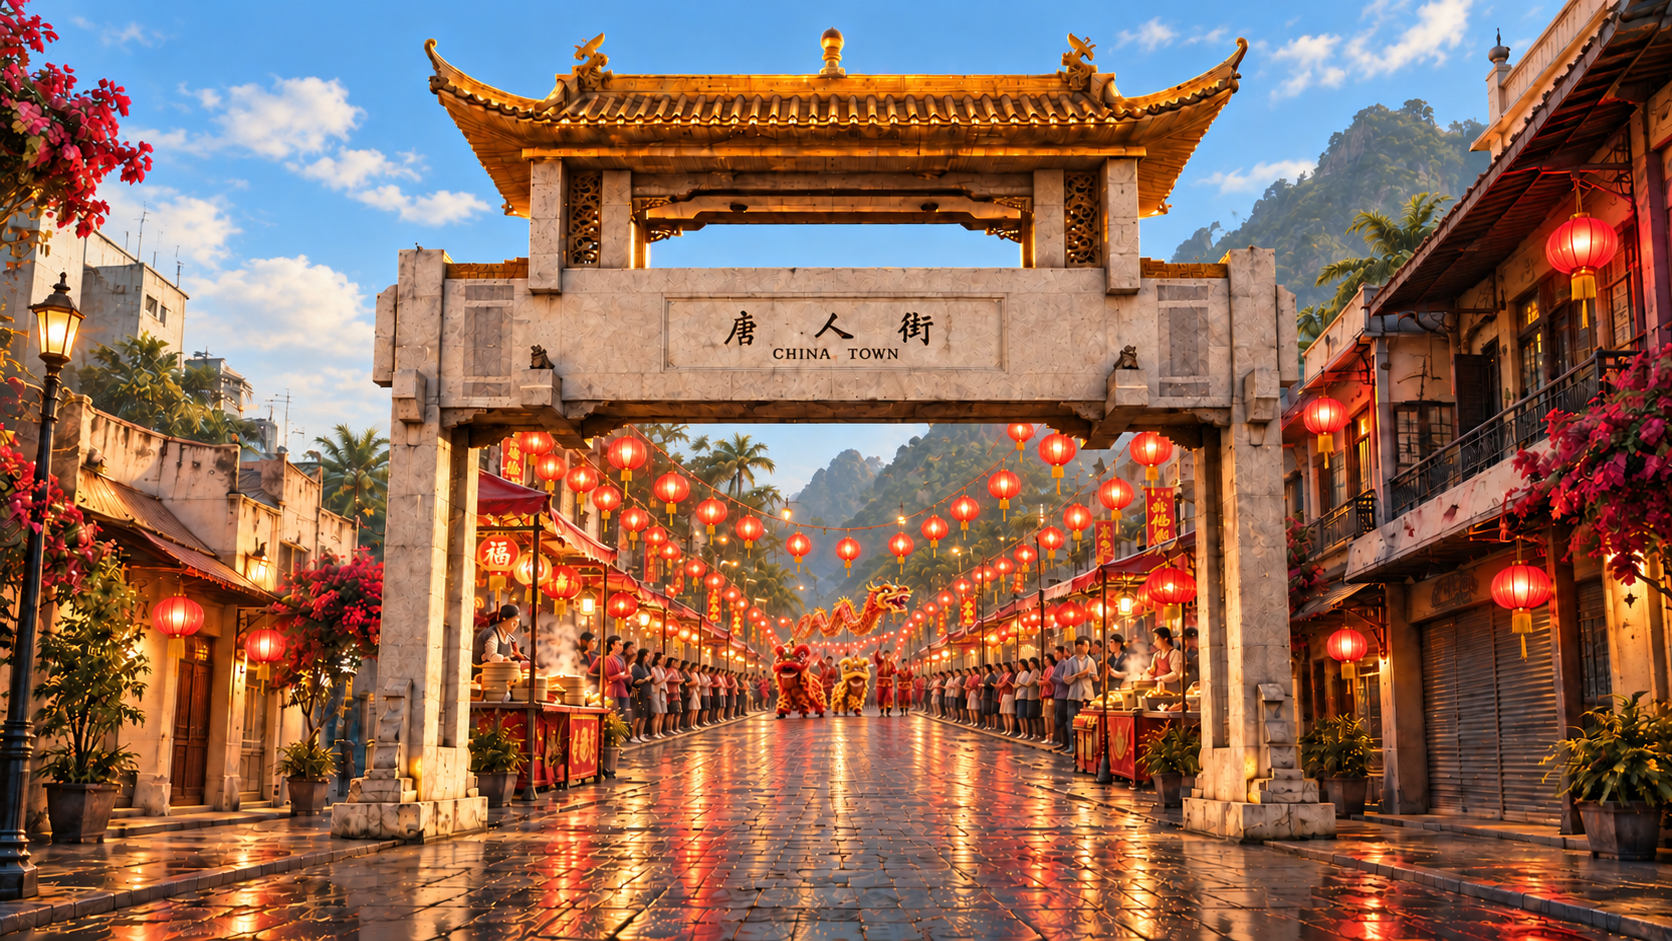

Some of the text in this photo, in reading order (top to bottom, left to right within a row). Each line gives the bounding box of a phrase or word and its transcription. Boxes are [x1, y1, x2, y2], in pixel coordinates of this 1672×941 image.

[724, 310, 934, 346] 唐人街
[772, 348, 899, 360] CHINA TOWN
[483, 541, 511, 566] 福
